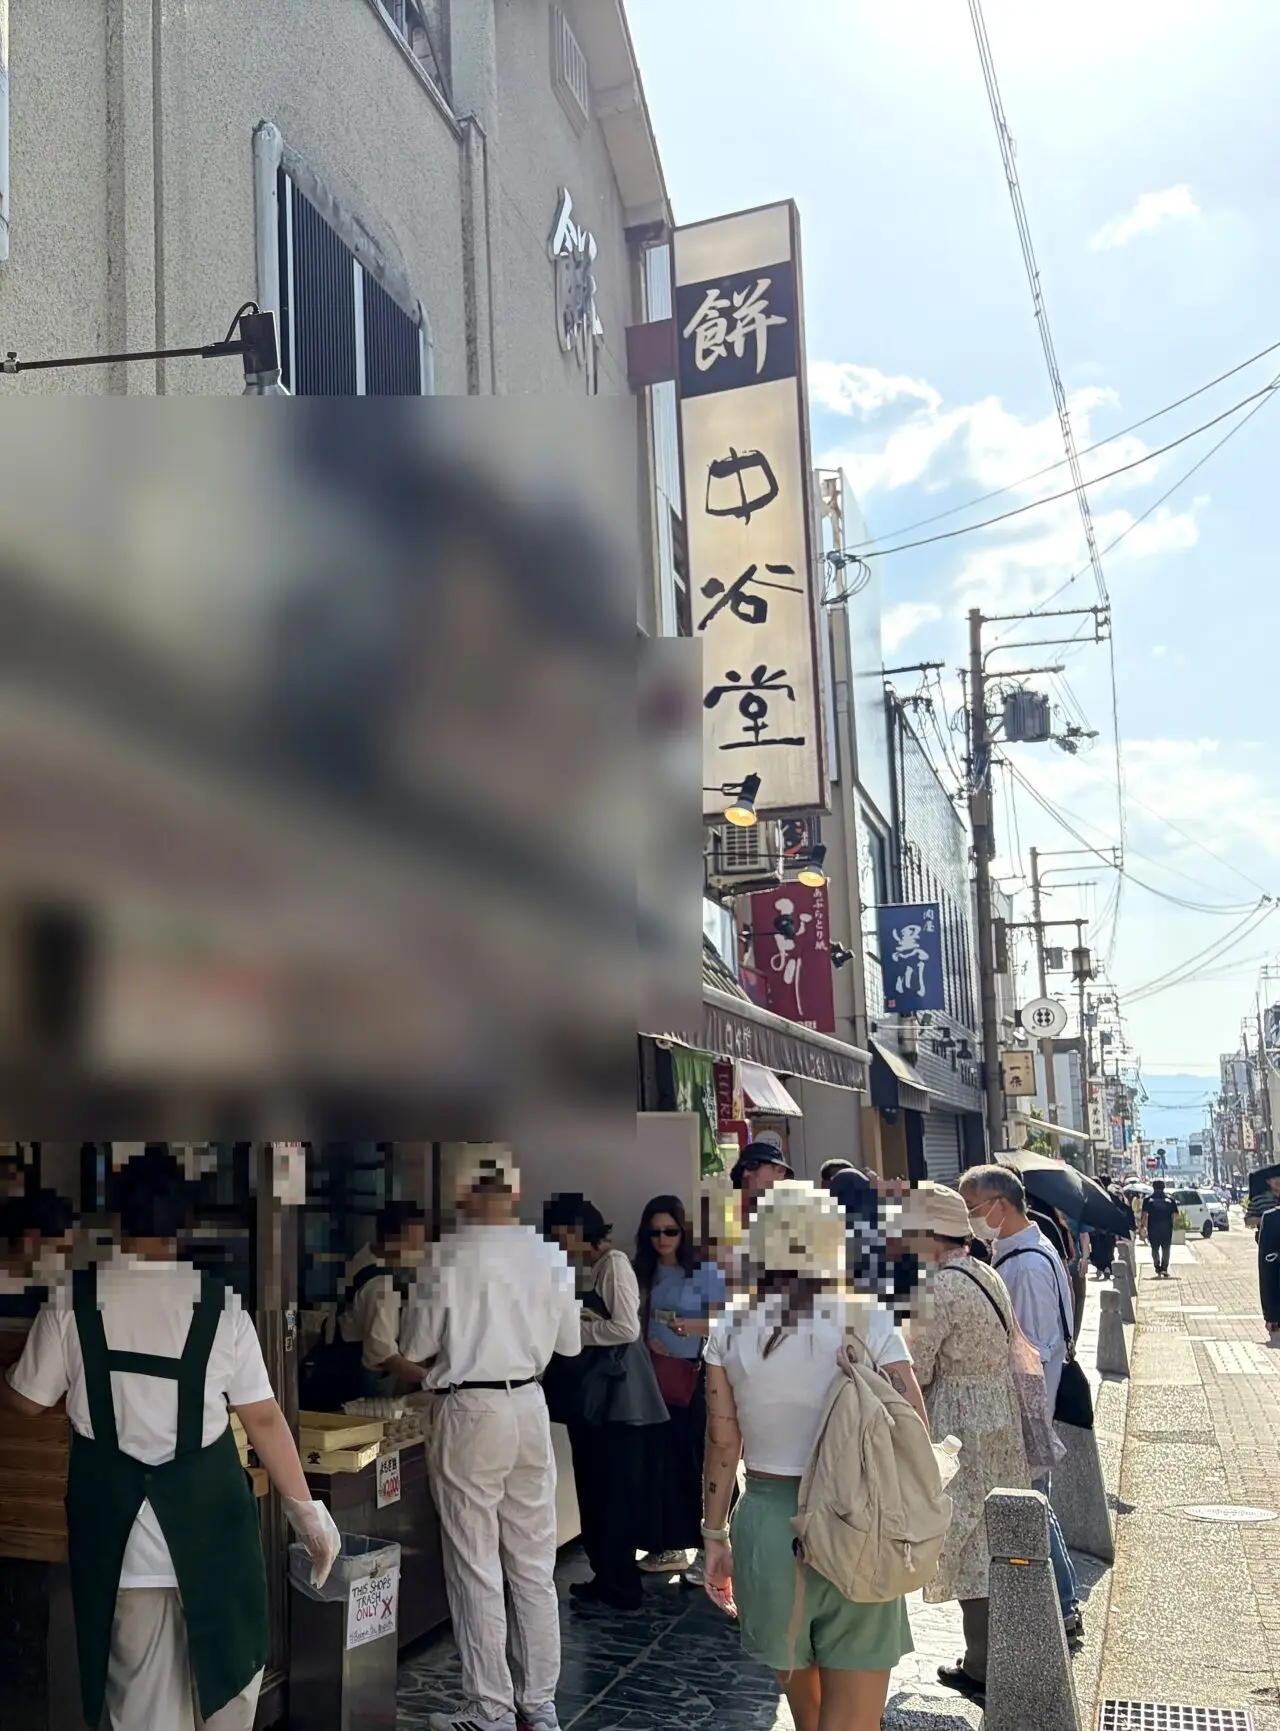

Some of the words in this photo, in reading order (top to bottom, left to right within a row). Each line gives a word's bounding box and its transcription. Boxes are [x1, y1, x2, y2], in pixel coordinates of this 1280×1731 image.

[683, 278, 787, 374] 餅
[698, 446, 805, 750] 中谷堂
[891, 924, 930, 998] 黒川
[352, 1582, 368, 1598] THIS
[370, 1575, 391, 1593] SHOP'S
[357, 1591, 381, 1608] TRASH
[356, 1604, 377, 1621] ONLY
